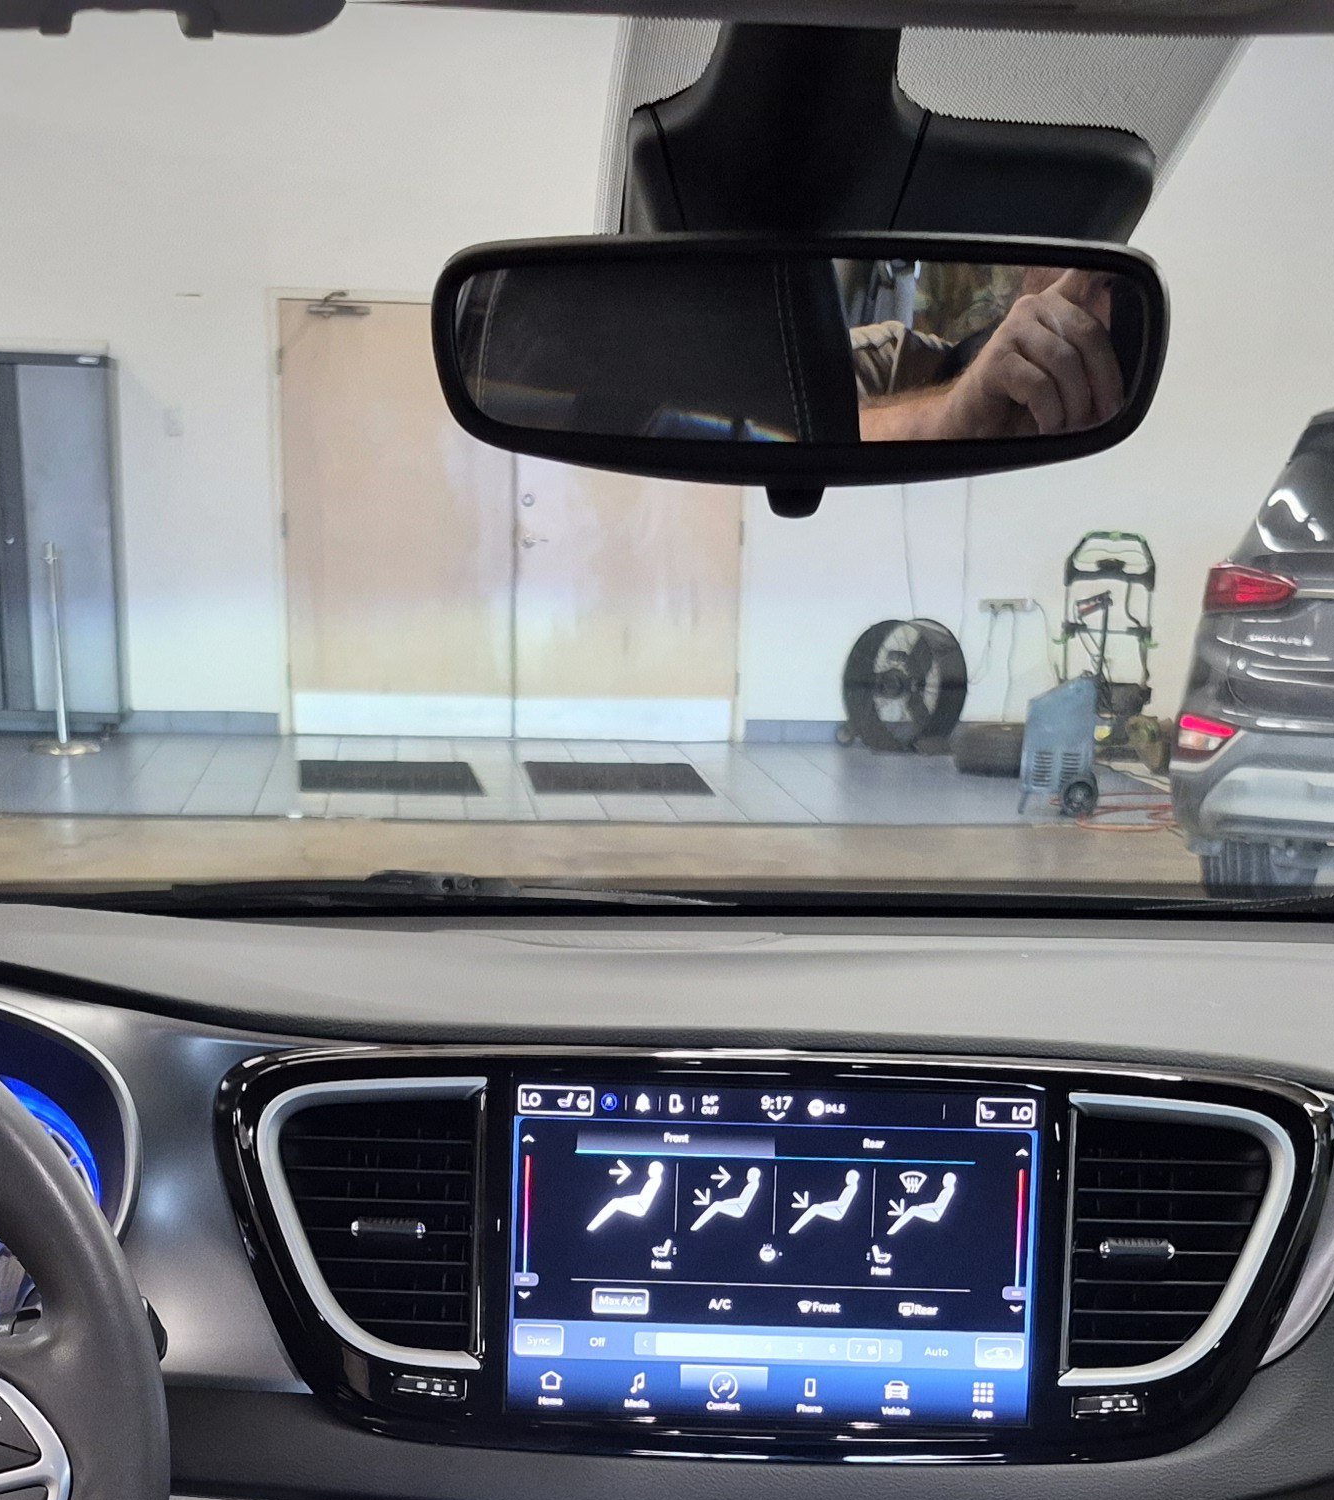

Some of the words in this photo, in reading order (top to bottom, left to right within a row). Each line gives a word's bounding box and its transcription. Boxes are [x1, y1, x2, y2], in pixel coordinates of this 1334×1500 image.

[521, 1092, 542, 1107] LO
[760, 1094, 794, 1111] 9:17
[1011, 1106, 1033, 1121] LO
[663, 1132, 690, 1144] Front
[862, 1137, 886, 1149] Rear
[598, 1295, 619, 1306] Max
[620, 1295, 643, 1307] A/C
[708, 1298, 732, 1310] A/C
[812, 1301, 841, 1313] Front
[914, 1304, 939, 1316] Rear
[526, 1335, 552, 1348] Sync
[589, 1336, 606, 1348] Off
[924, 1346, 949, 1358] Auto
[538, 1396, 564, 1407] Home
[624, 1398, 650, 1409] Media
[705, 1401, 741, 1412] Comfort
[796, 1403, 823, 1414] Phone
[880, 1405, 911, 1417] Vehicle
[971, 1409, 993, 1420] Apps
